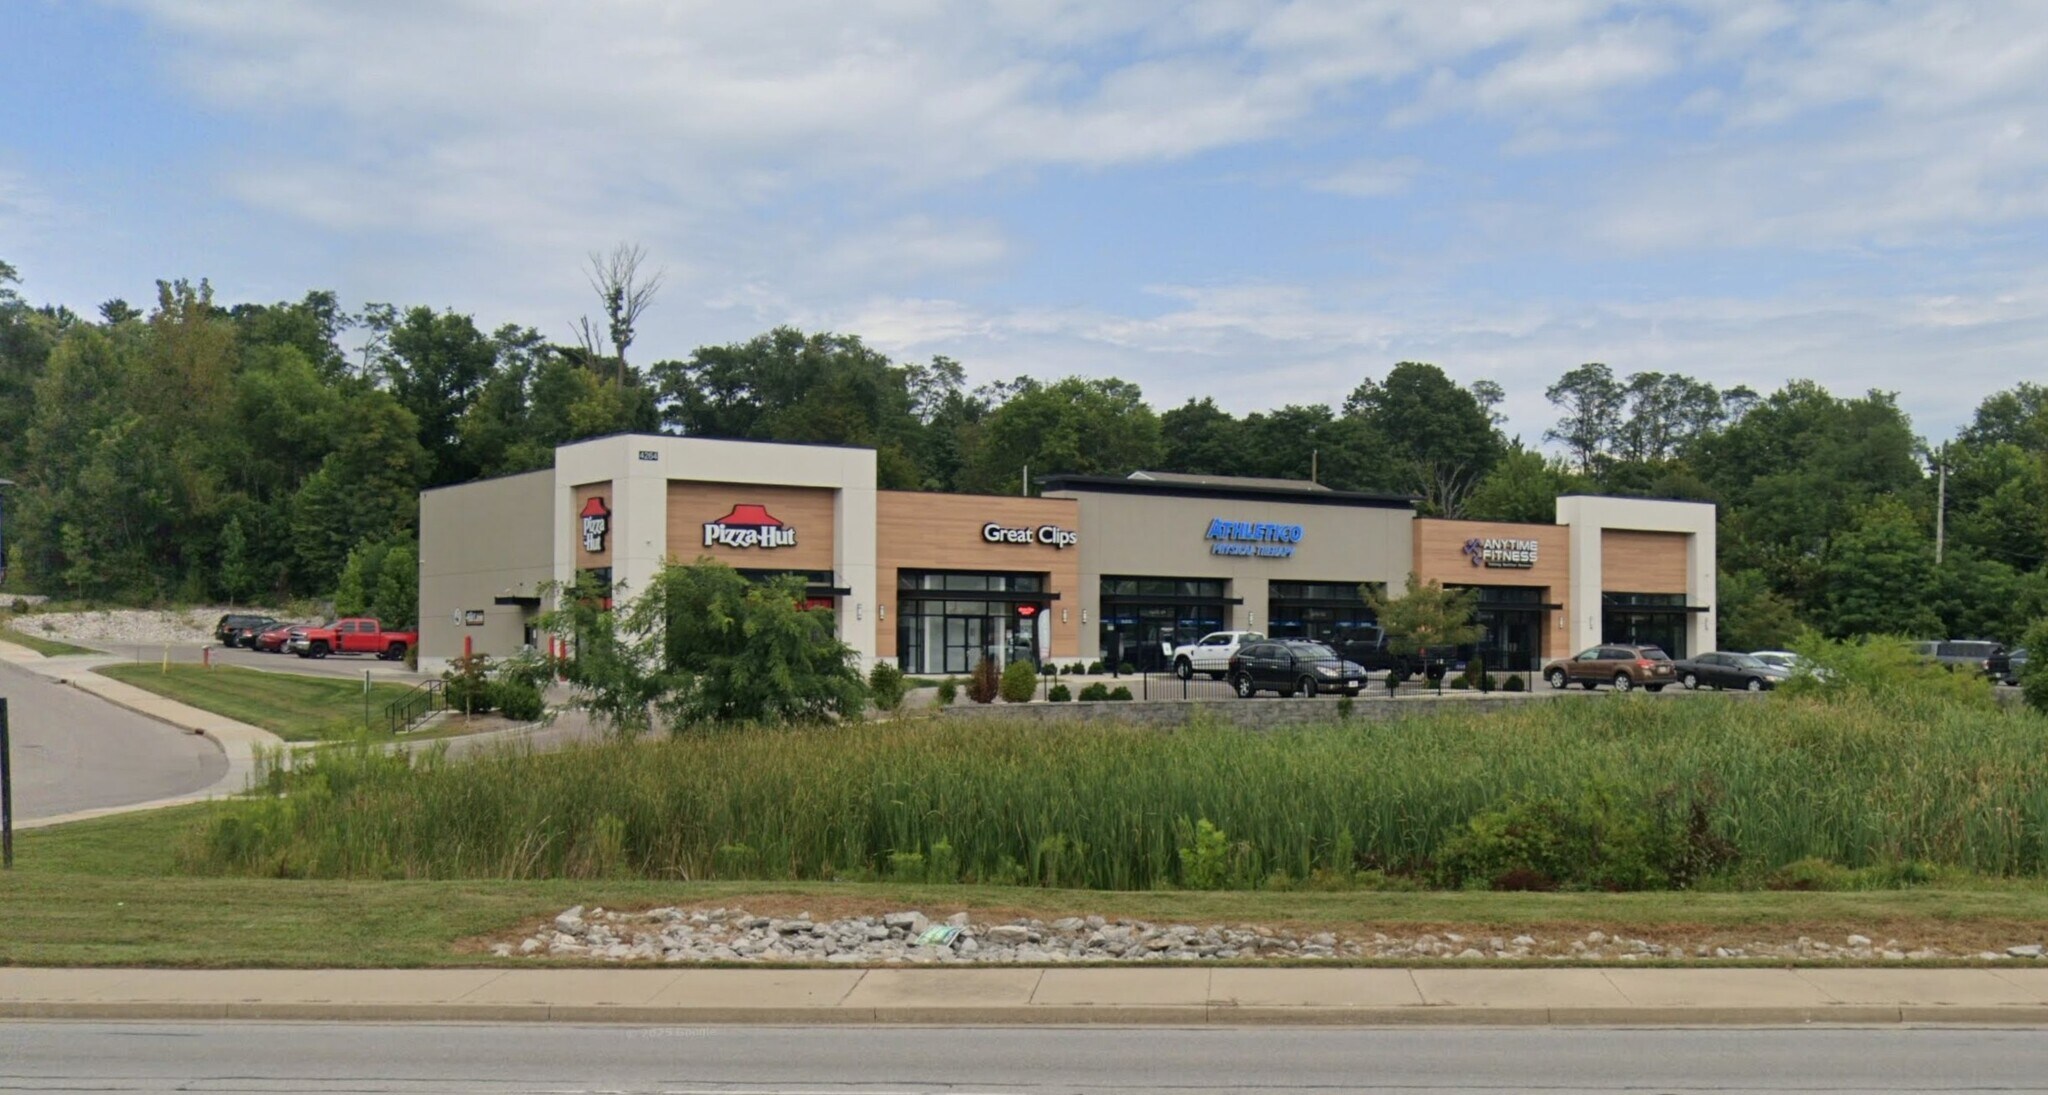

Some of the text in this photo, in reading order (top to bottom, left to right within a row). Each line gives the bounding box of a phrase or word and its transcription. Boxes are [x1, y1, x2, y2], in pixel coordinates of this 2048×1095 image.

[583, 515, 605, 535] Pizza
[704, 523, 796, 547] Pizza Hut
[983, 522, 1078, 548] Great Clips
[1206, 517, 1305, 543] ATHLETICO
[583, 528, 601, 551] Hut
[1483, 538, 1538, 551] ANYTIME
[1255, 545, 1295, 557] THERAPY
[1482, 549, 1538, 562] FITNESS
